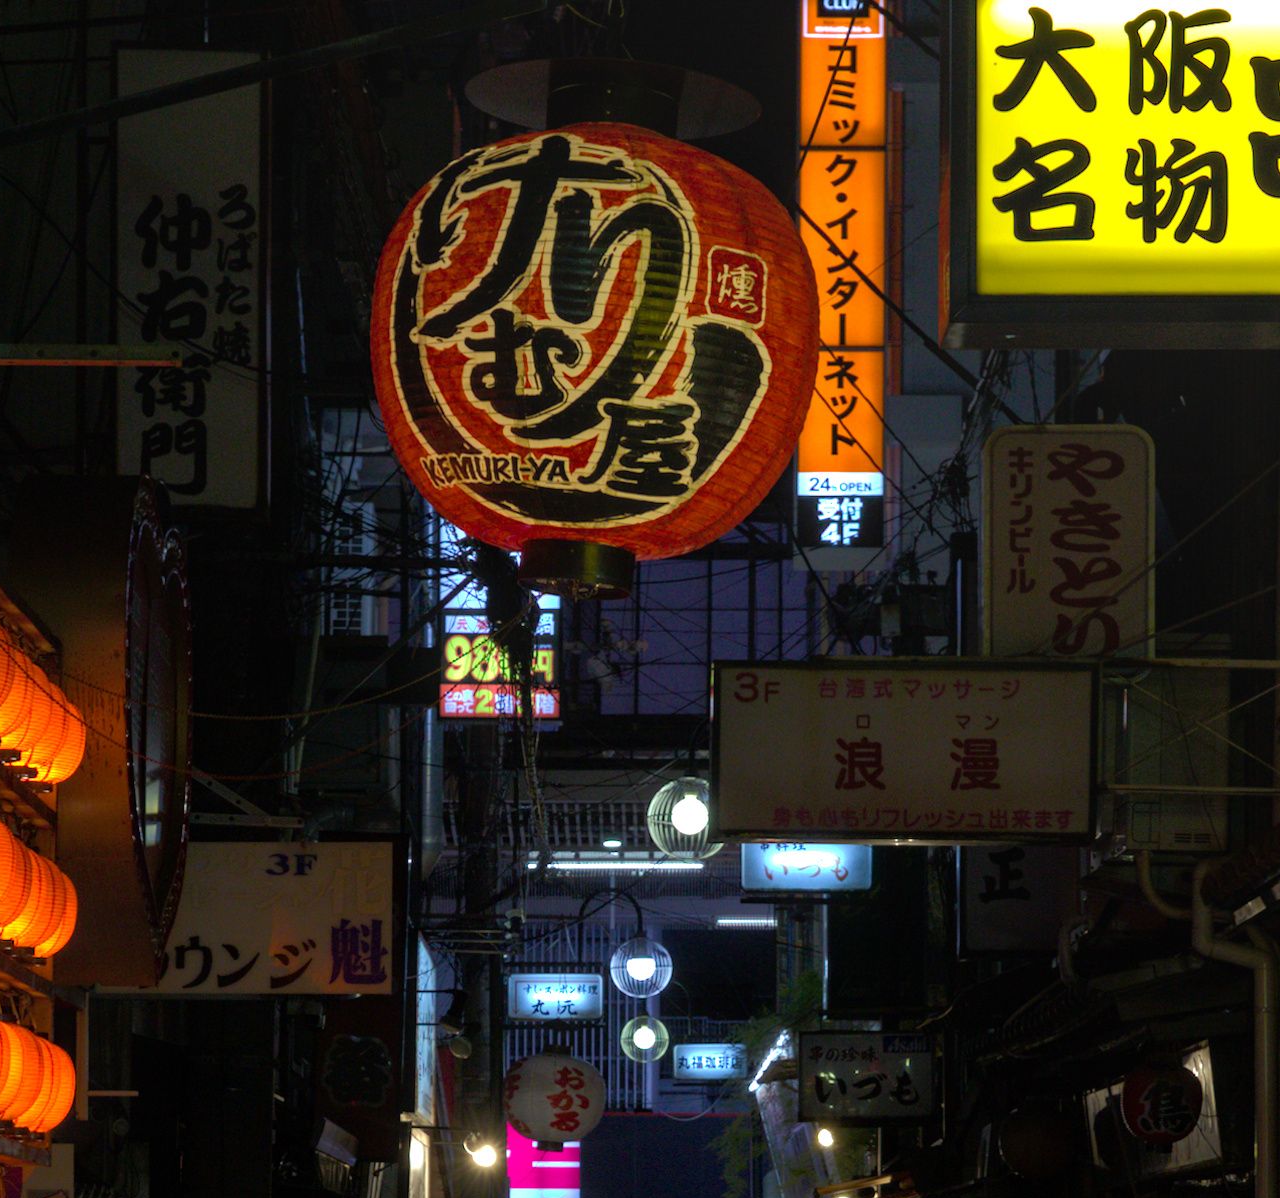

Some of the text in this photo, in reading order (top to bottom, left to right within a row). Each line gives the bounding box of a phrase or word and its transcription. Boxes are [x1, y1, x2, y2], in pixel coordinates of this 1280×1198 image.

[993, 7, 1232, 114] 大阪
[993, 137, 1228, 244] 名物
[215, 184, 257, 366] ろばた焼
[824, 45, 862, 455] コミック・インターネット
[135, 193, 212, 496] 仲右衛門
[422, 454, 570, 486] KEMURI-YA
[840, 483, 872, 491] OPEN
[817, 498, 863, 520] 受付
[821, 523, 860, 545] 4F
[1006, 447, 1036, 594] キリンビール
[1047, 443, 1124, 655] やきとり
[735, 672, 781, 702] 3F
[820, 679, 1021, 700] 台湾式マッサージ
[835, 737, 1001, 790] 浪漫
[266, 853, 317, 875] 3F
[329, 918, 388, 985] 魁
